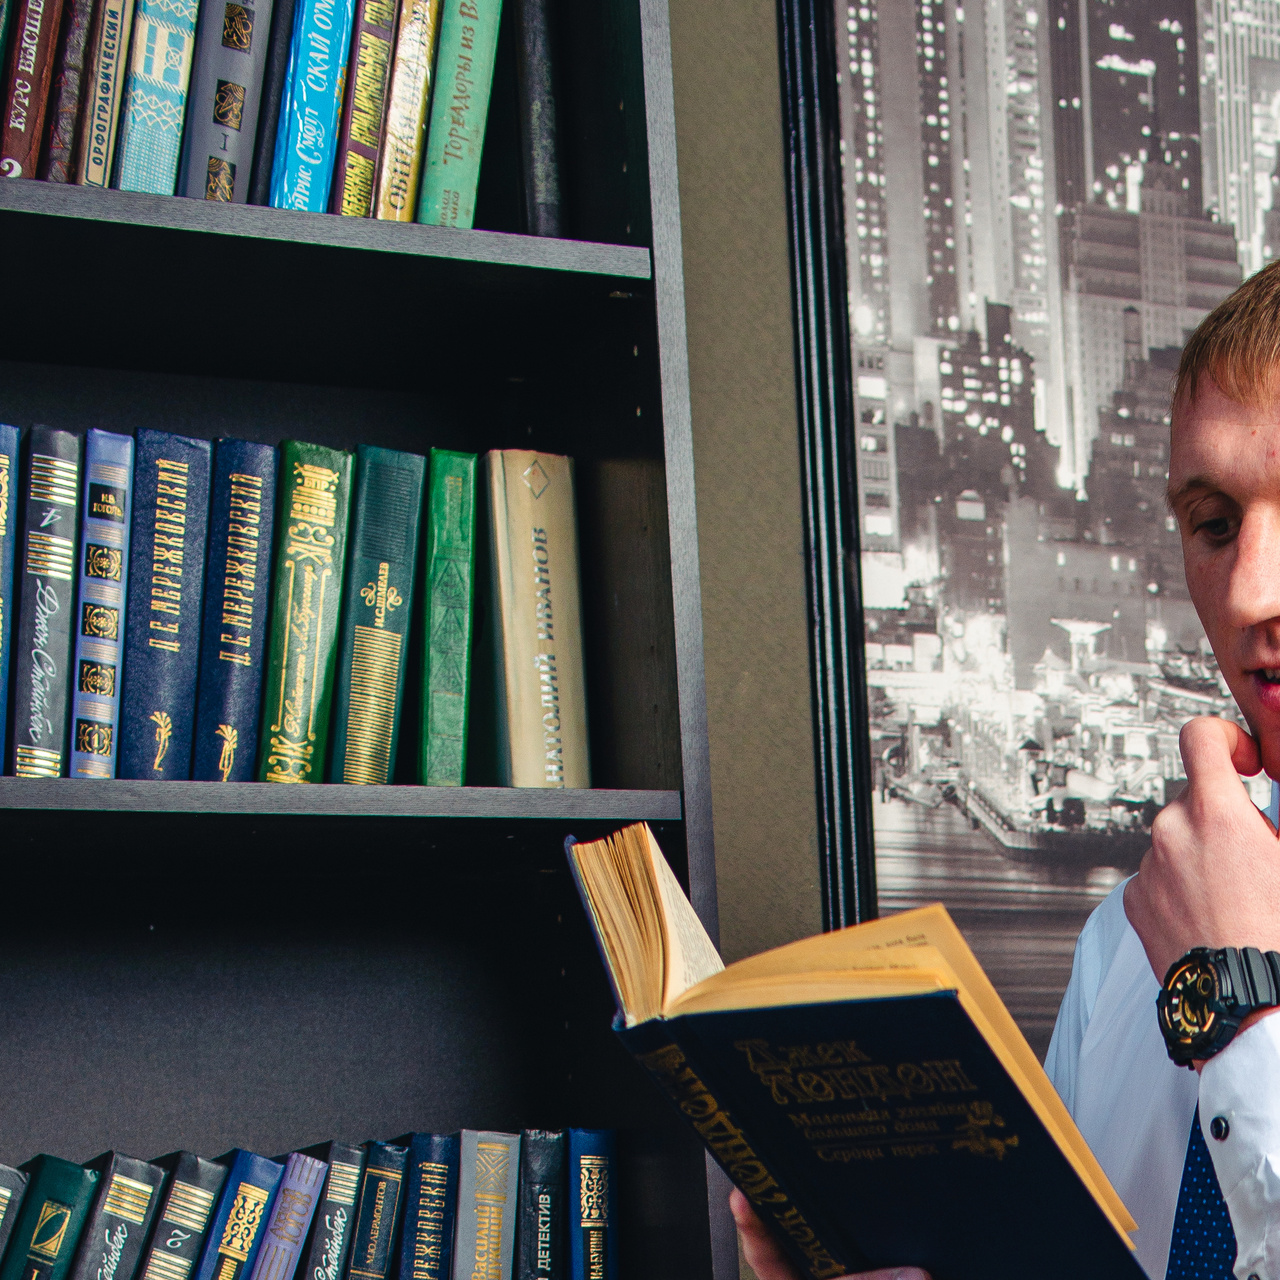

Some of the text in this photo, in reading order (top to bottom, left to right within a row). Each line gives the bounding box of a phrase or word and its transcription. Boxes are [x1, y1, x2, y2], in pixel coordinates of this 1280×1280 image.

[10, 79, 31, 133] КУРС
[92, 9, 119, 166] ОРФОГРАФИЧЕСКИЙ
[306, 29, 331, 92] СКАЙ
[150, 458, 190, 616] МЕРЕЖКОВСКИЙ
[222, 472, 263, 629] МЕРЕЖКОВСКИЙ
[29, 578, 60, 745] Джон Стейнбек
[531, 527, 565, 789] НАТОЛИЙ ИВАНОВ
[538, 1194, 552, 1271] ДЕТЕКТИВ
